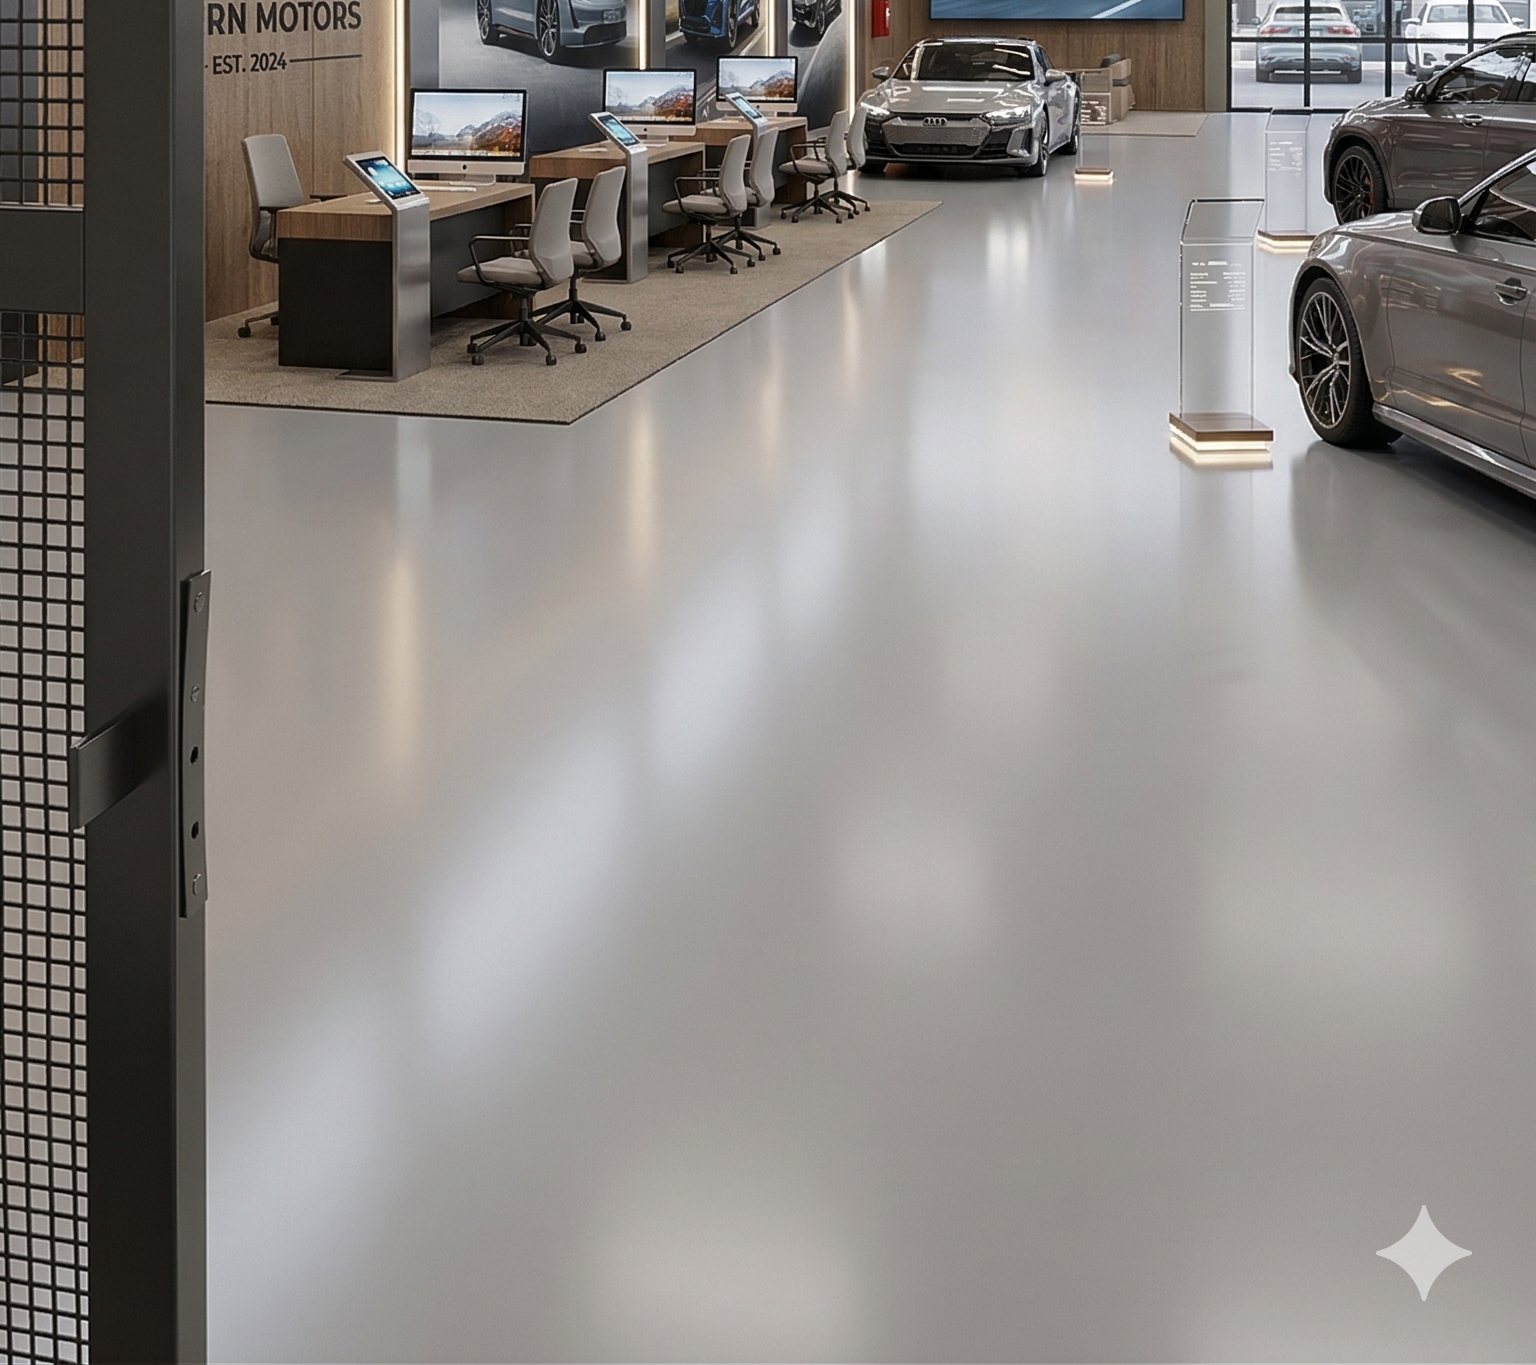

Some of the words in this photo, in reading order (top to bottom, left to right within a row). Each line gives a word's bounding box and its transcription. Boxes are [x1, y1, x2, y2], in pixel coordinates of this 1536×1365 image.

[256, 0, 362, 33] MOTORS
[212, 54, 246, 75] EST.
[250, 51, 288, 72] 2024
